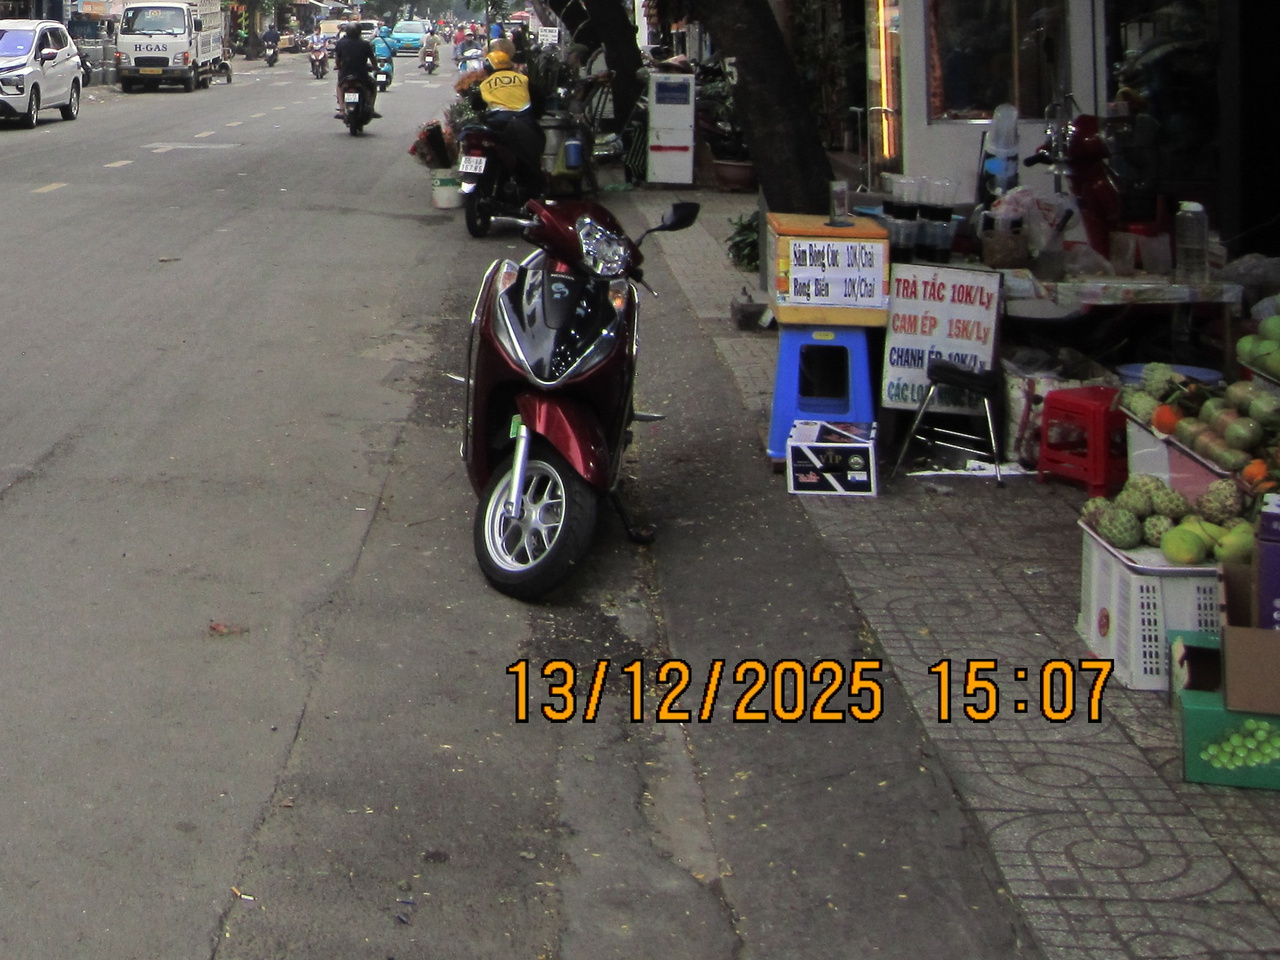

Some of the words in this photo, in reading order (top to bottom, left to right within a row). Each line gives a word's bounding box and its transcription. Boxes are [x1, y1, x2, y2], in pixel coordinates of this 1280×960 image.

[134, 44, 168, 52] H-GAS
[486, 75, 523, 91] TADA
[847, 243, 874, 272] 10K/Chai
[793, 277, 811, 301] Rong
[844, 276, 875, 301] 10K/Chai
[895, 274, 918, 299] TRÀ
[922, 273, 945, 302] TẮC
[951, 284, 994, 310] 10K/Ly
[892, 312, 919, 335] CAM
[920, 310, 938, 336] ÉP
[947, 318, 991, 345] 15K/Ly
[889, 346, 925, 369] CHANH
[888, 377, 909, 401] CÁC
[819, 454, 842, 463] VIP
